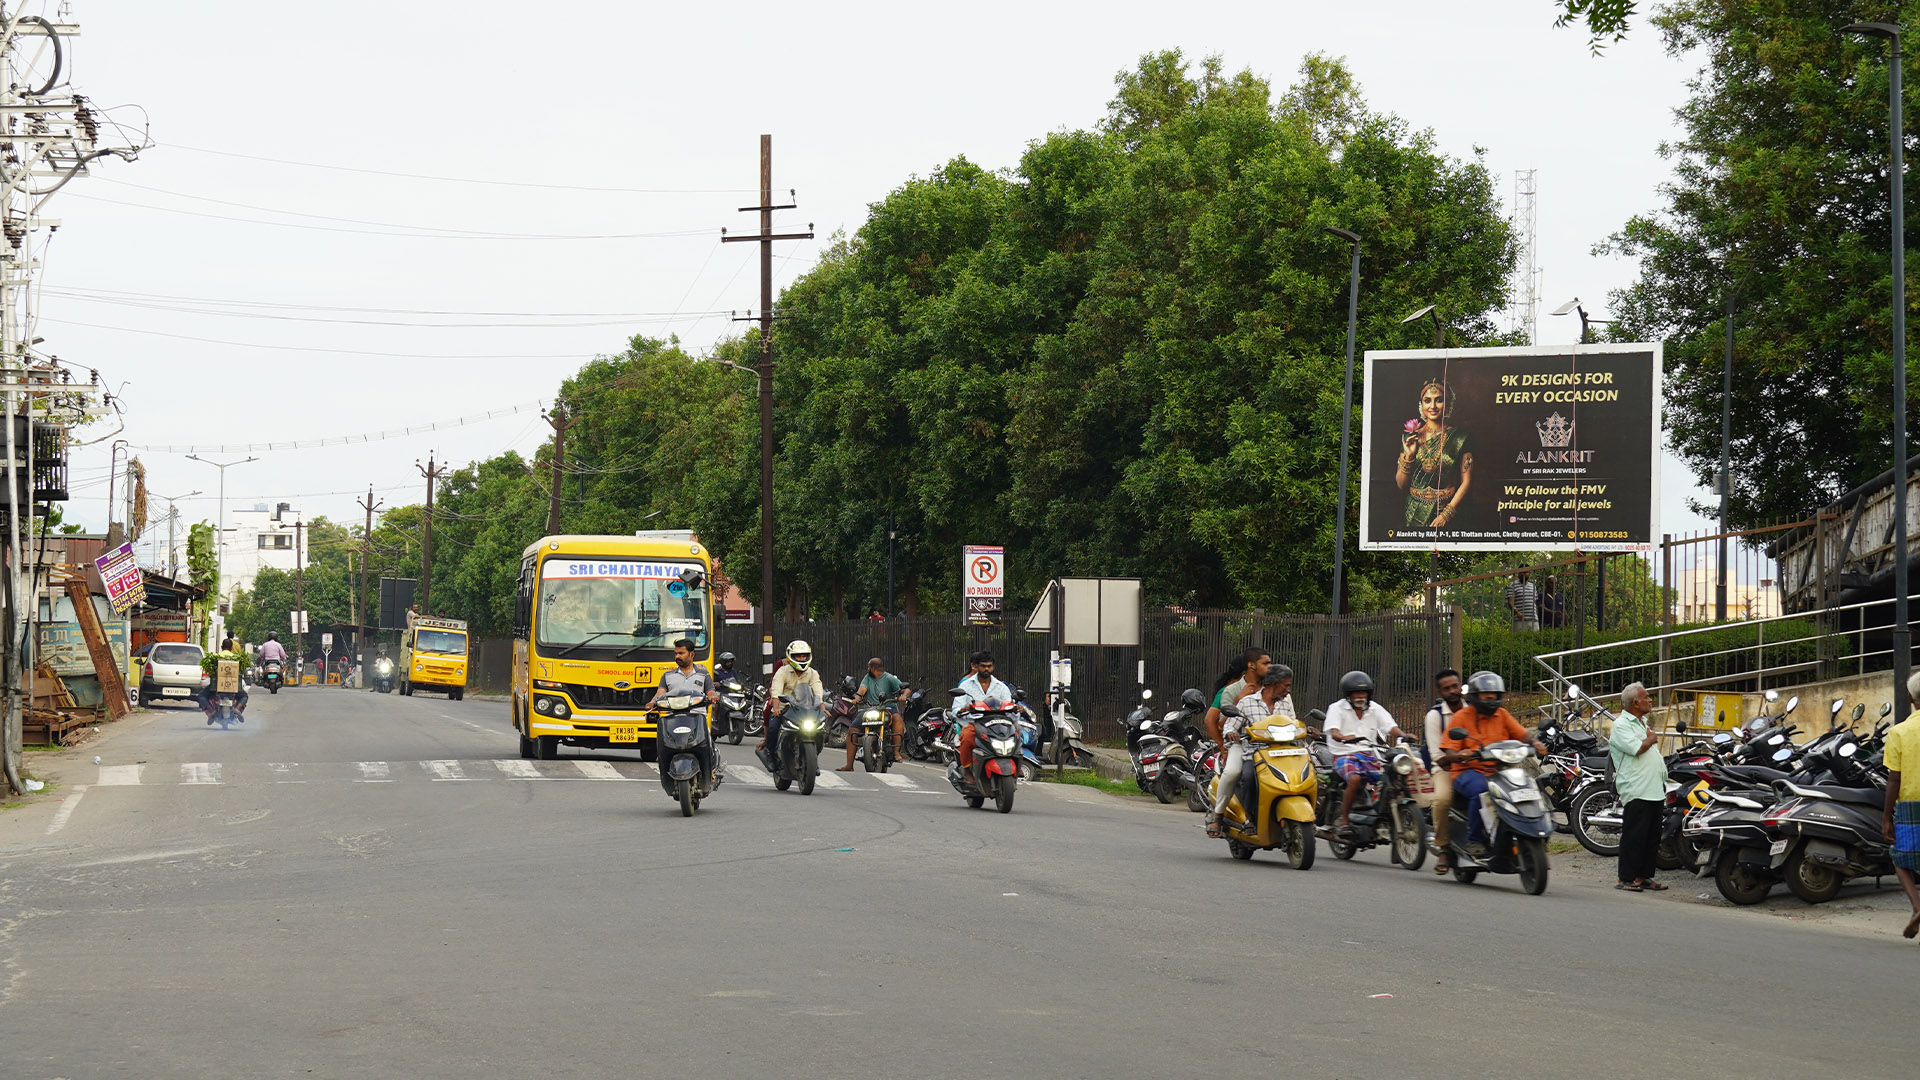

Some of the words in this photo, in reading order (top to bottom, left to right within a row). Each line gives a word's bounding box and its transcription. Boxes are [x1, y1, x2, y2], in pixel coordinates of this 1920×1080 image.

[1501, 375, 1519, 386] 9K
[1522, 373, 1581, 386] DESIGNS
[1584, 372, 1613, 384] FOR
[1495, 391, 1540, 404] EVERY
[1543, 390, 1619, 403] OCCASION
[1515, 450, 1596, 463] ALANKRIT
[1504, 485, 1523, 495] We
[1524, 485, 1559, 497] follow
[1561, 485, 1578, 495] the
[1580, 484, 1607, 495] FMV
[1497, 499, 1543, 512] principle
[1544, 499, 1561, 512] for
[1562, 499, 1576, 509] all
[1577, 499, 1612, 512] jewels
[1502, 531, 1520, 539] Chetty
[1579, 531, 1628, 539] 9150873583
[569, 564, 594, 575] SRI
[598, 563, 681, 577] CHAITANYA
[967, 586, 976, 596] NO
[976, 586, 1002, 596] PARKING
[425, 620, 459, 629] JESUS
[130, 689, 138, 702] 6
